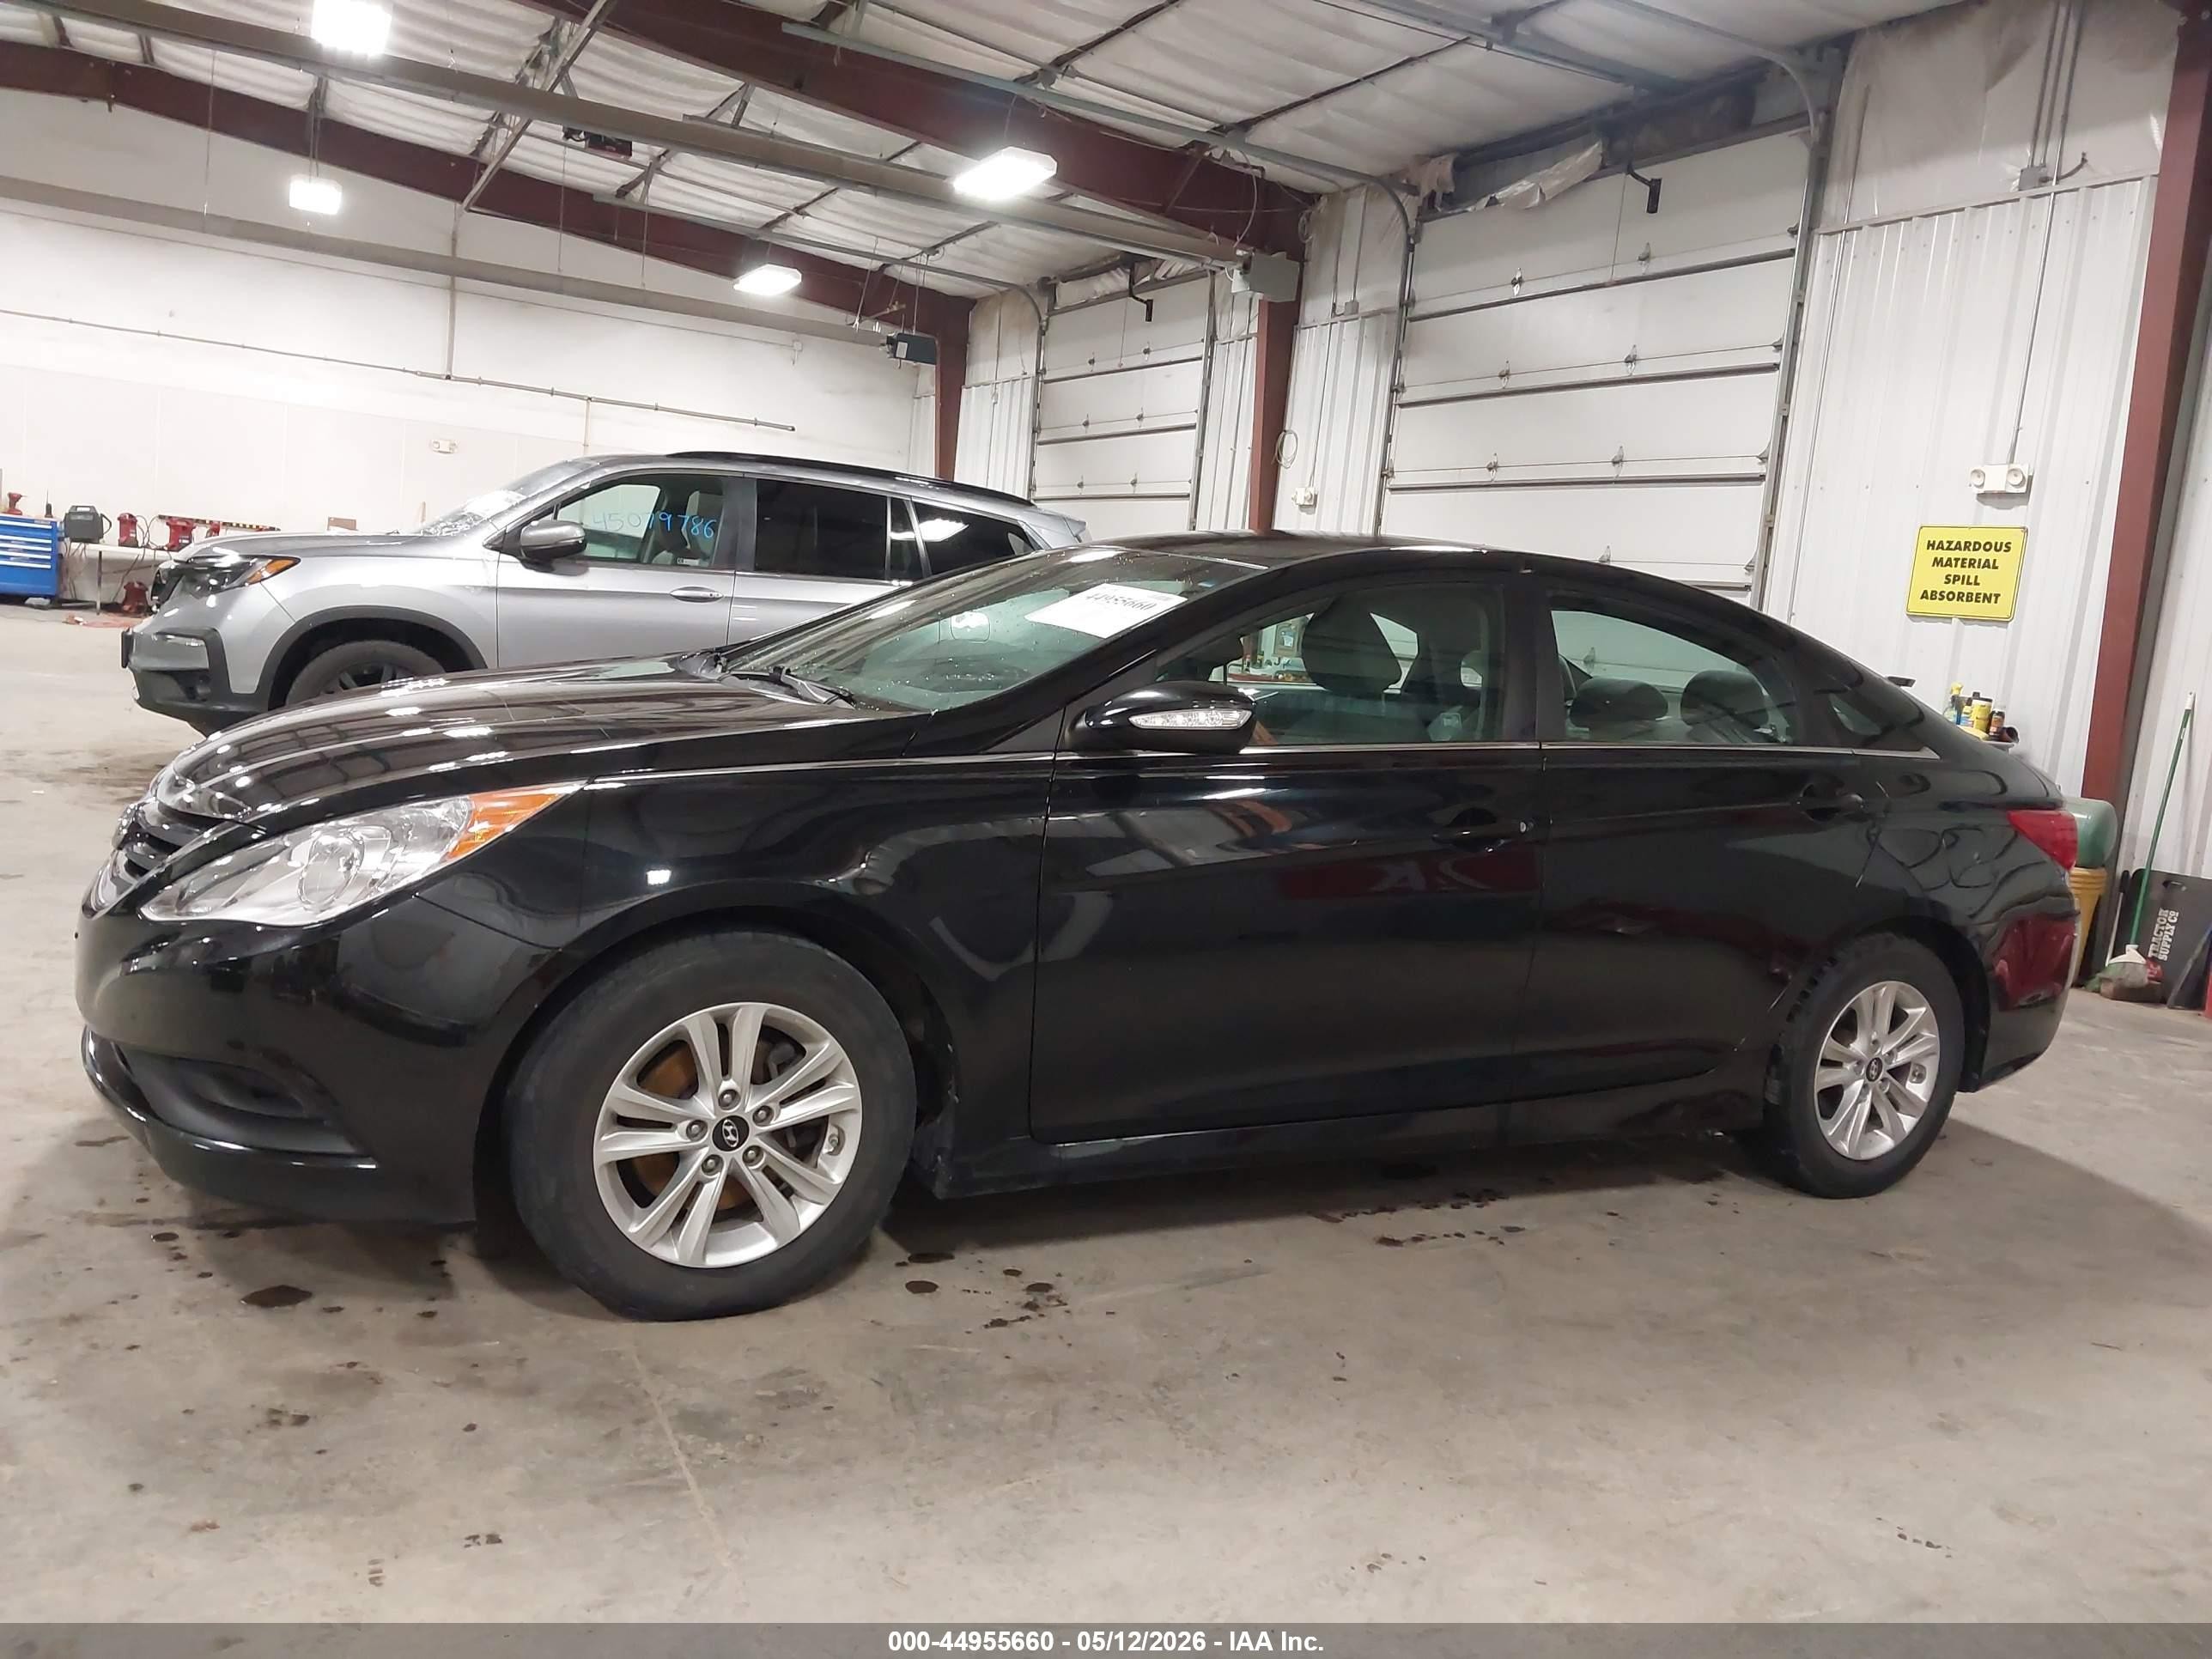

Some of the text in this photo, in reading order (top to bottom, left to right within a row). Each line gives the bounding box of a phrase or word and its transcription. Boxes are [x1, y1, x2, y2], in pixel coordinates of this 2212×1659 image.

[592, 511, 717, 538] 45079786
[1926, 540, 2012, 552] HAZARDOUS
[1931, 556, 1999, 569] MATERIAL
[1943, 574, 1981, 586] SPILL
[1920, 590, 2001, 604] ABSORBENT
[2148, 908, 2169, 957] TRACTOR
[2158, 922, 2176, 961] SUPPLY
